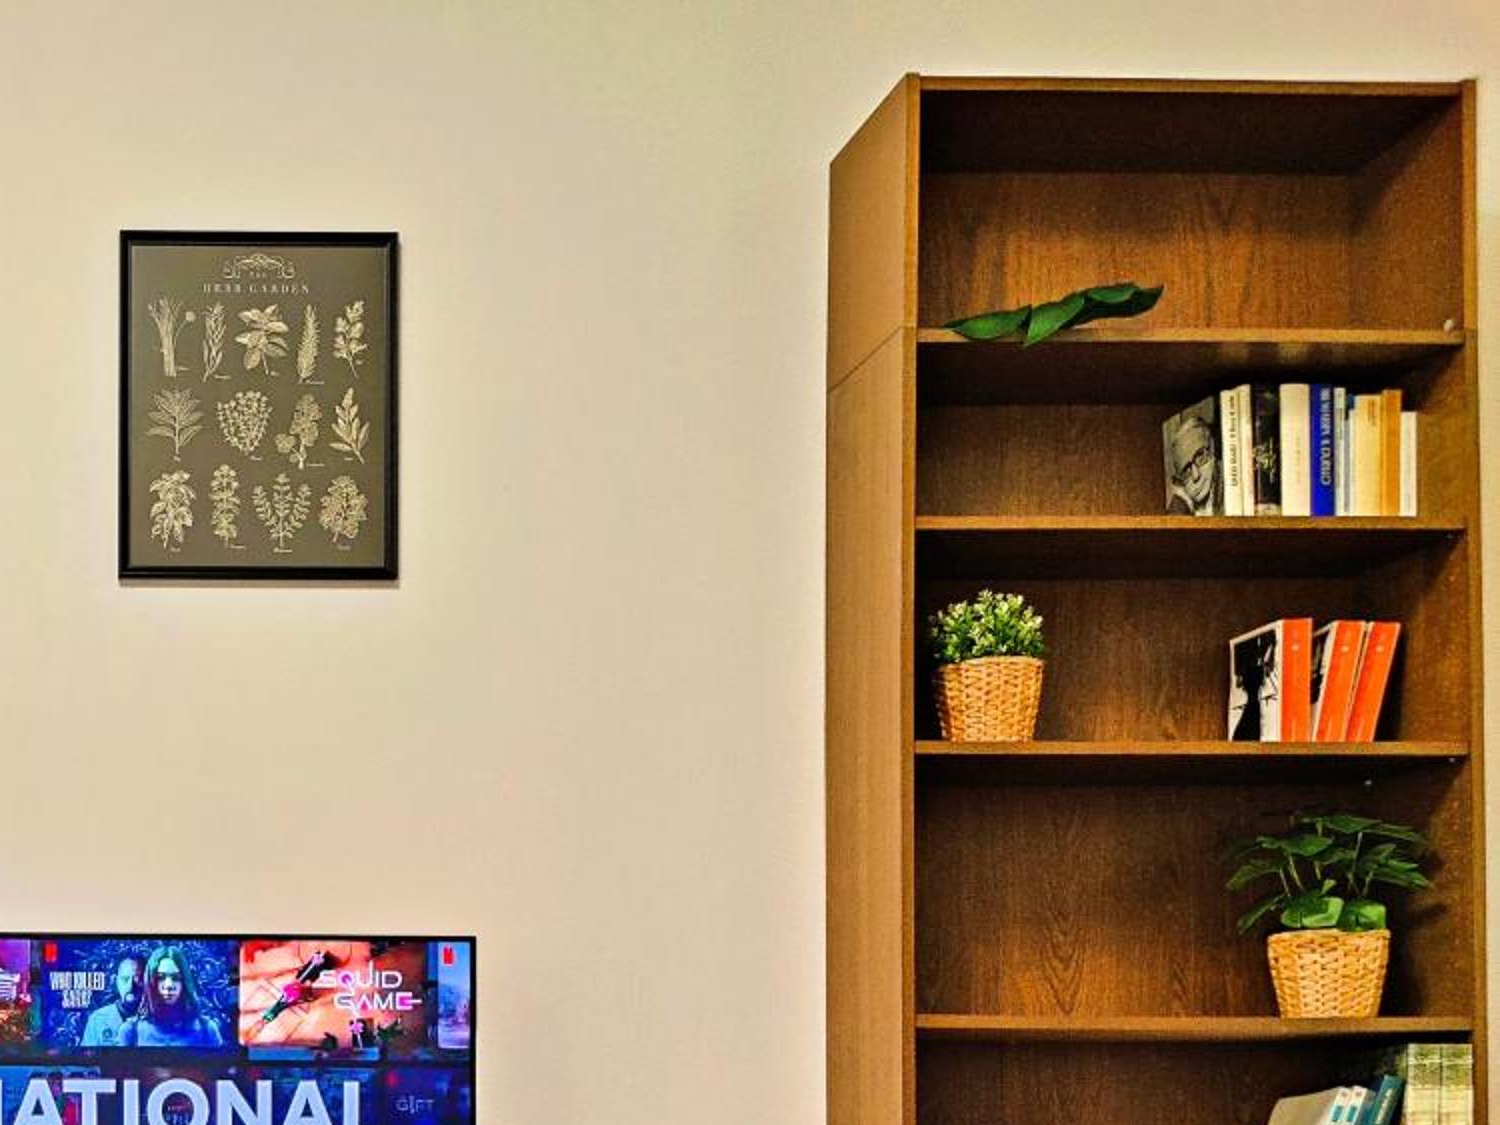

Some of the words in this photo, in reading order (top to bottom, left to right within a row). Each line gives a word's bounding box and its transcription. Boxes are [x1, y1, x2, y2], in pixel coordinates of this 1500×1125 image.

[248, 283, 309, 295] GARDEN
[312, 960, 403, 989] SQUID
[333, 990, 422, 1011] GAME
